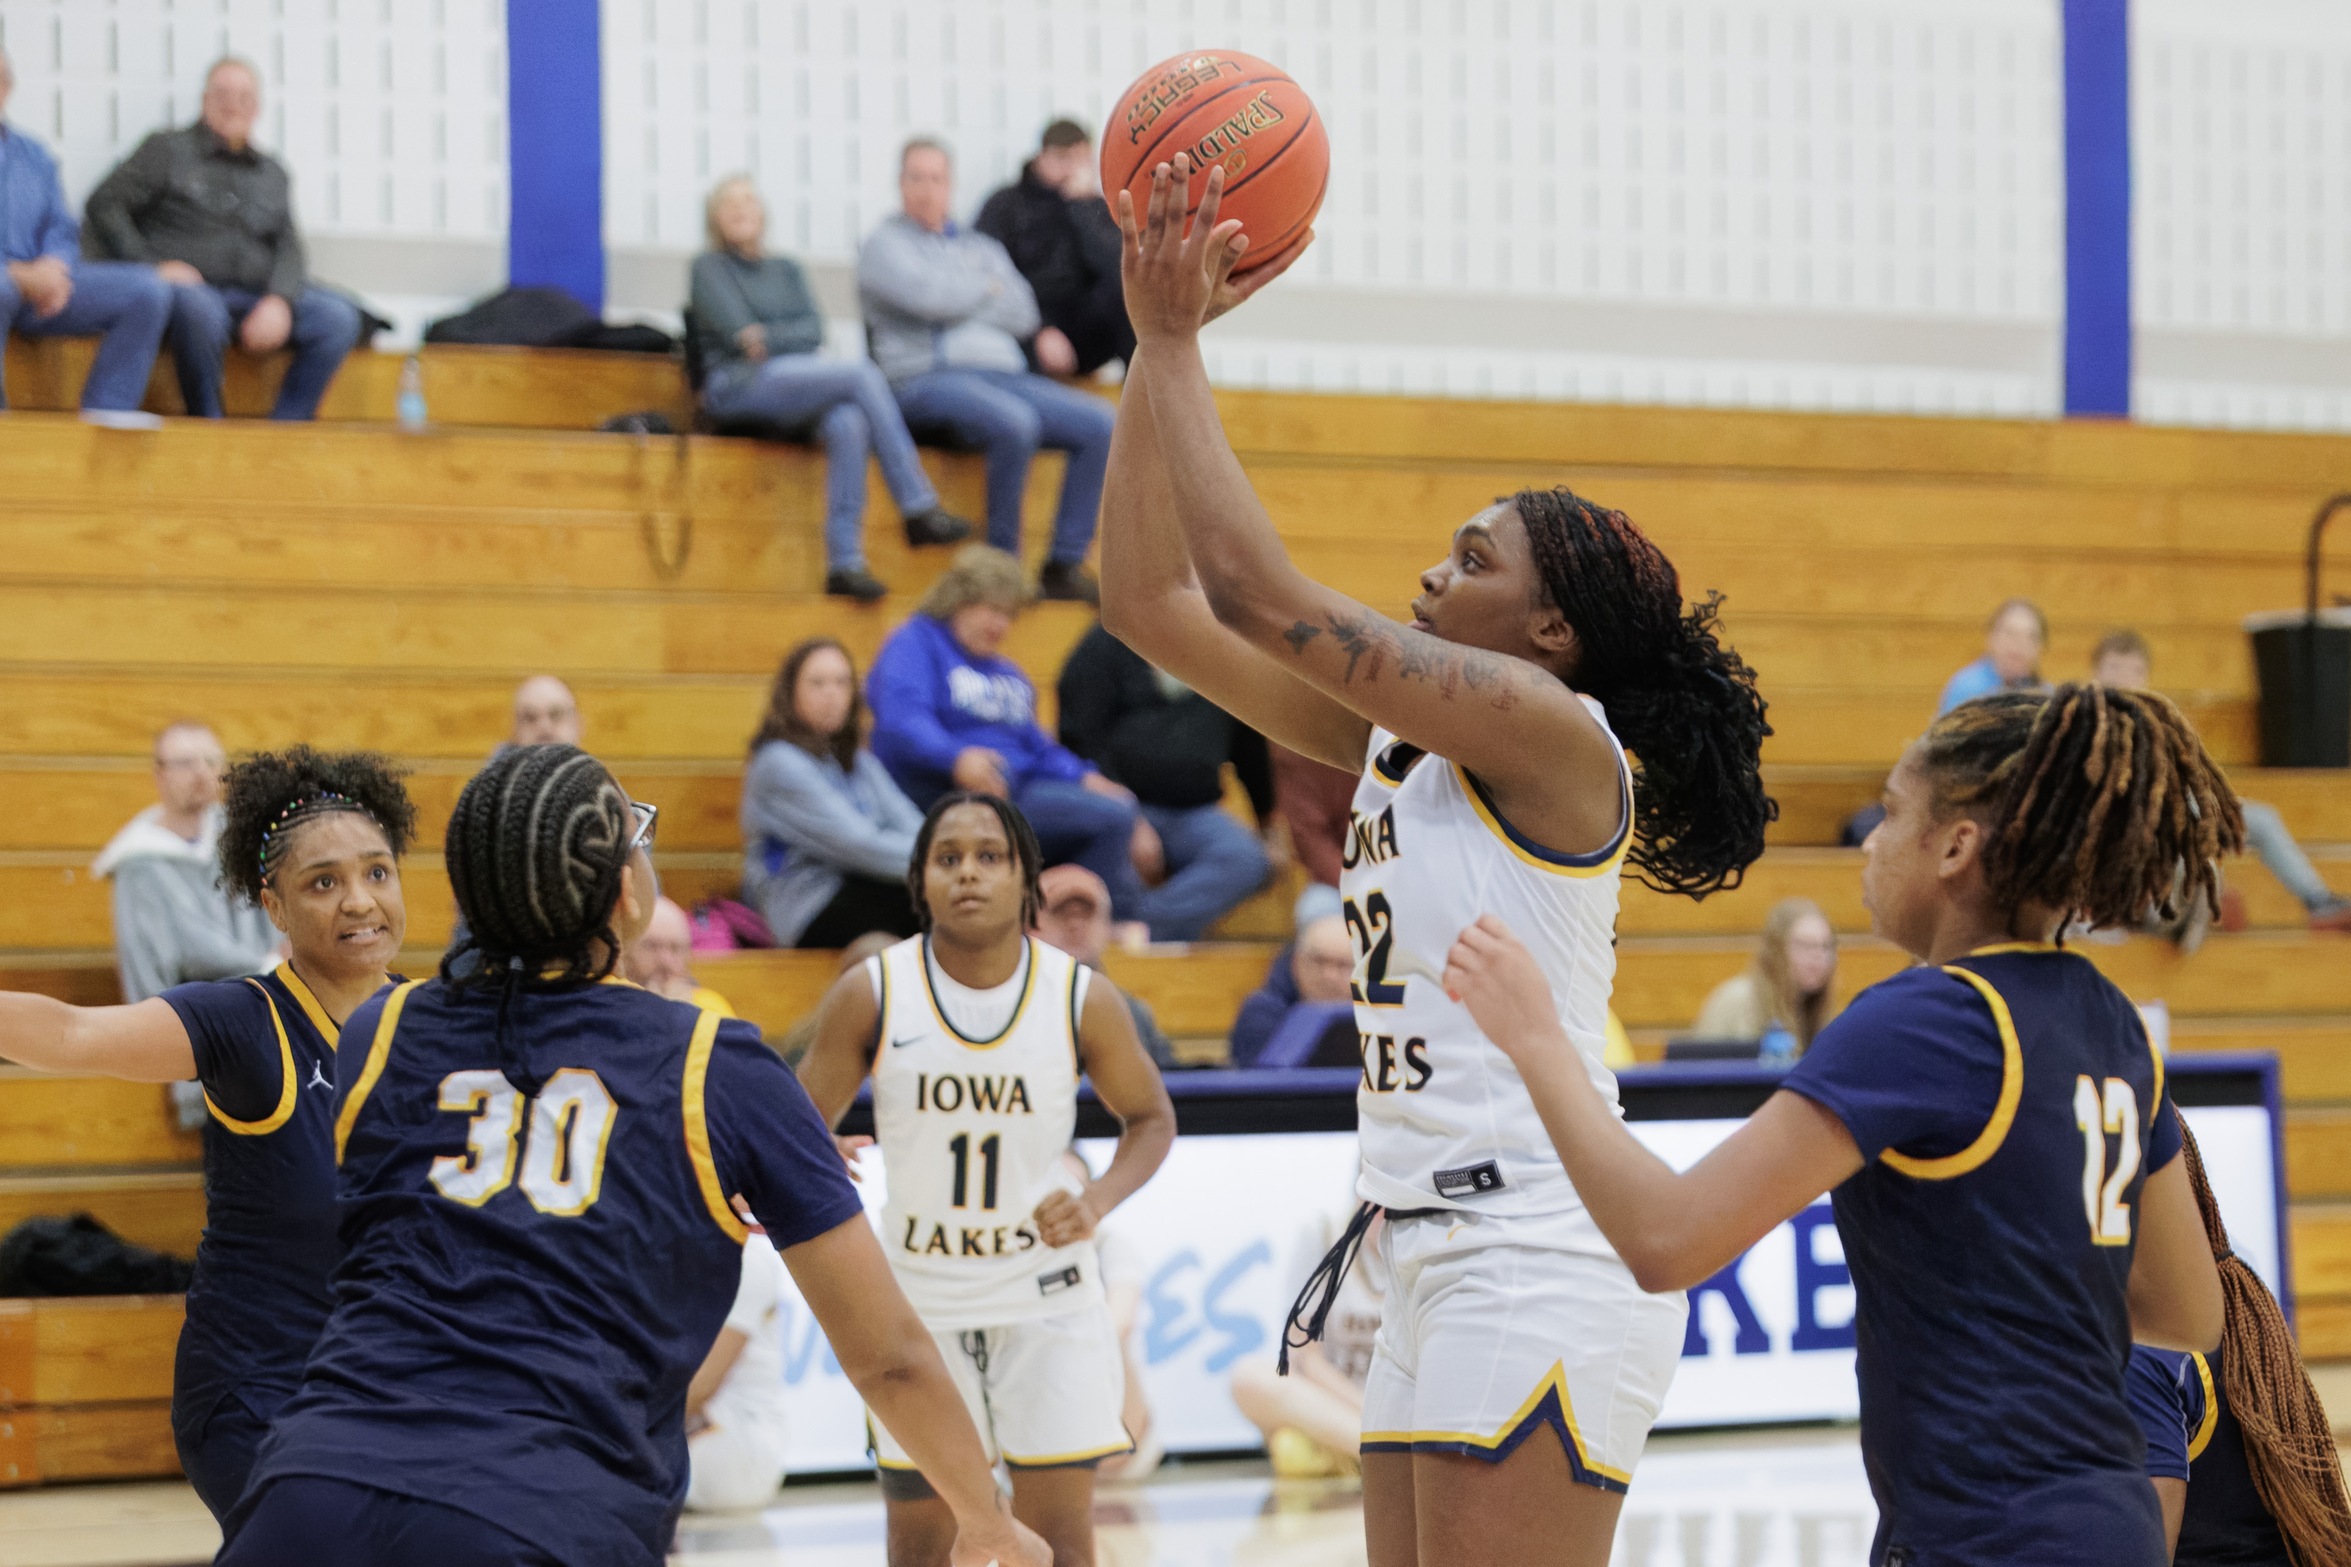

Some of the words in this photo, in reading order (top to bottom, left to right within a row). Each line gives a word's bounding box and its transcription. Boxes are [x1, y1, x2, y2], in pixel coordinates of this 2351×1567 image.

[1129, 61, 1242, 145] LEGACY
[1151, 89, 1285, 176] SPALDI
[916, 1072, 1035, 1114] IOWA
[427, 1067, 619, 1218] 30
[948, 1130, 1001, 1212] 11
[1479, 1172, 1492, 1186] S
[2073, 1073, 2142, 1246] 12
[904, 1214, 1038, 1257] LAKES
